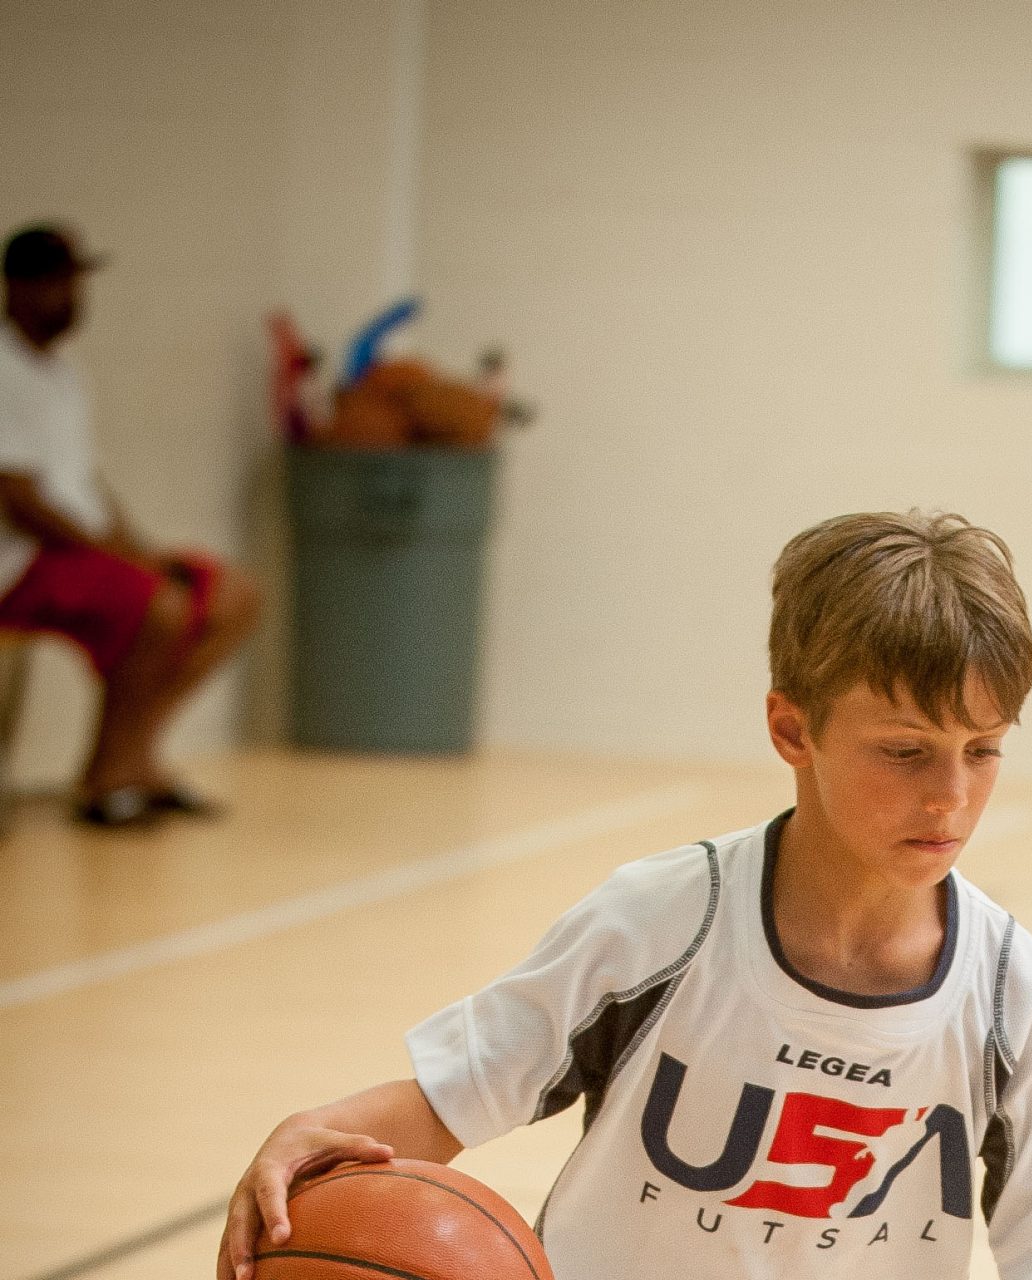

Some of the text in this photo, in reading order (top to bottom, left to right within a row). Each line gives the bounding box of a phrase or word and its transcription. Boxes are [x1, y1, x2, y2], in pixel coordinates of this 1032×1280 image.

[775, 1043, 893, 1088] LEGEA
[640, 1051, 973, 1220] USA
[639, 1180, 938, 1250] FUTSAL
